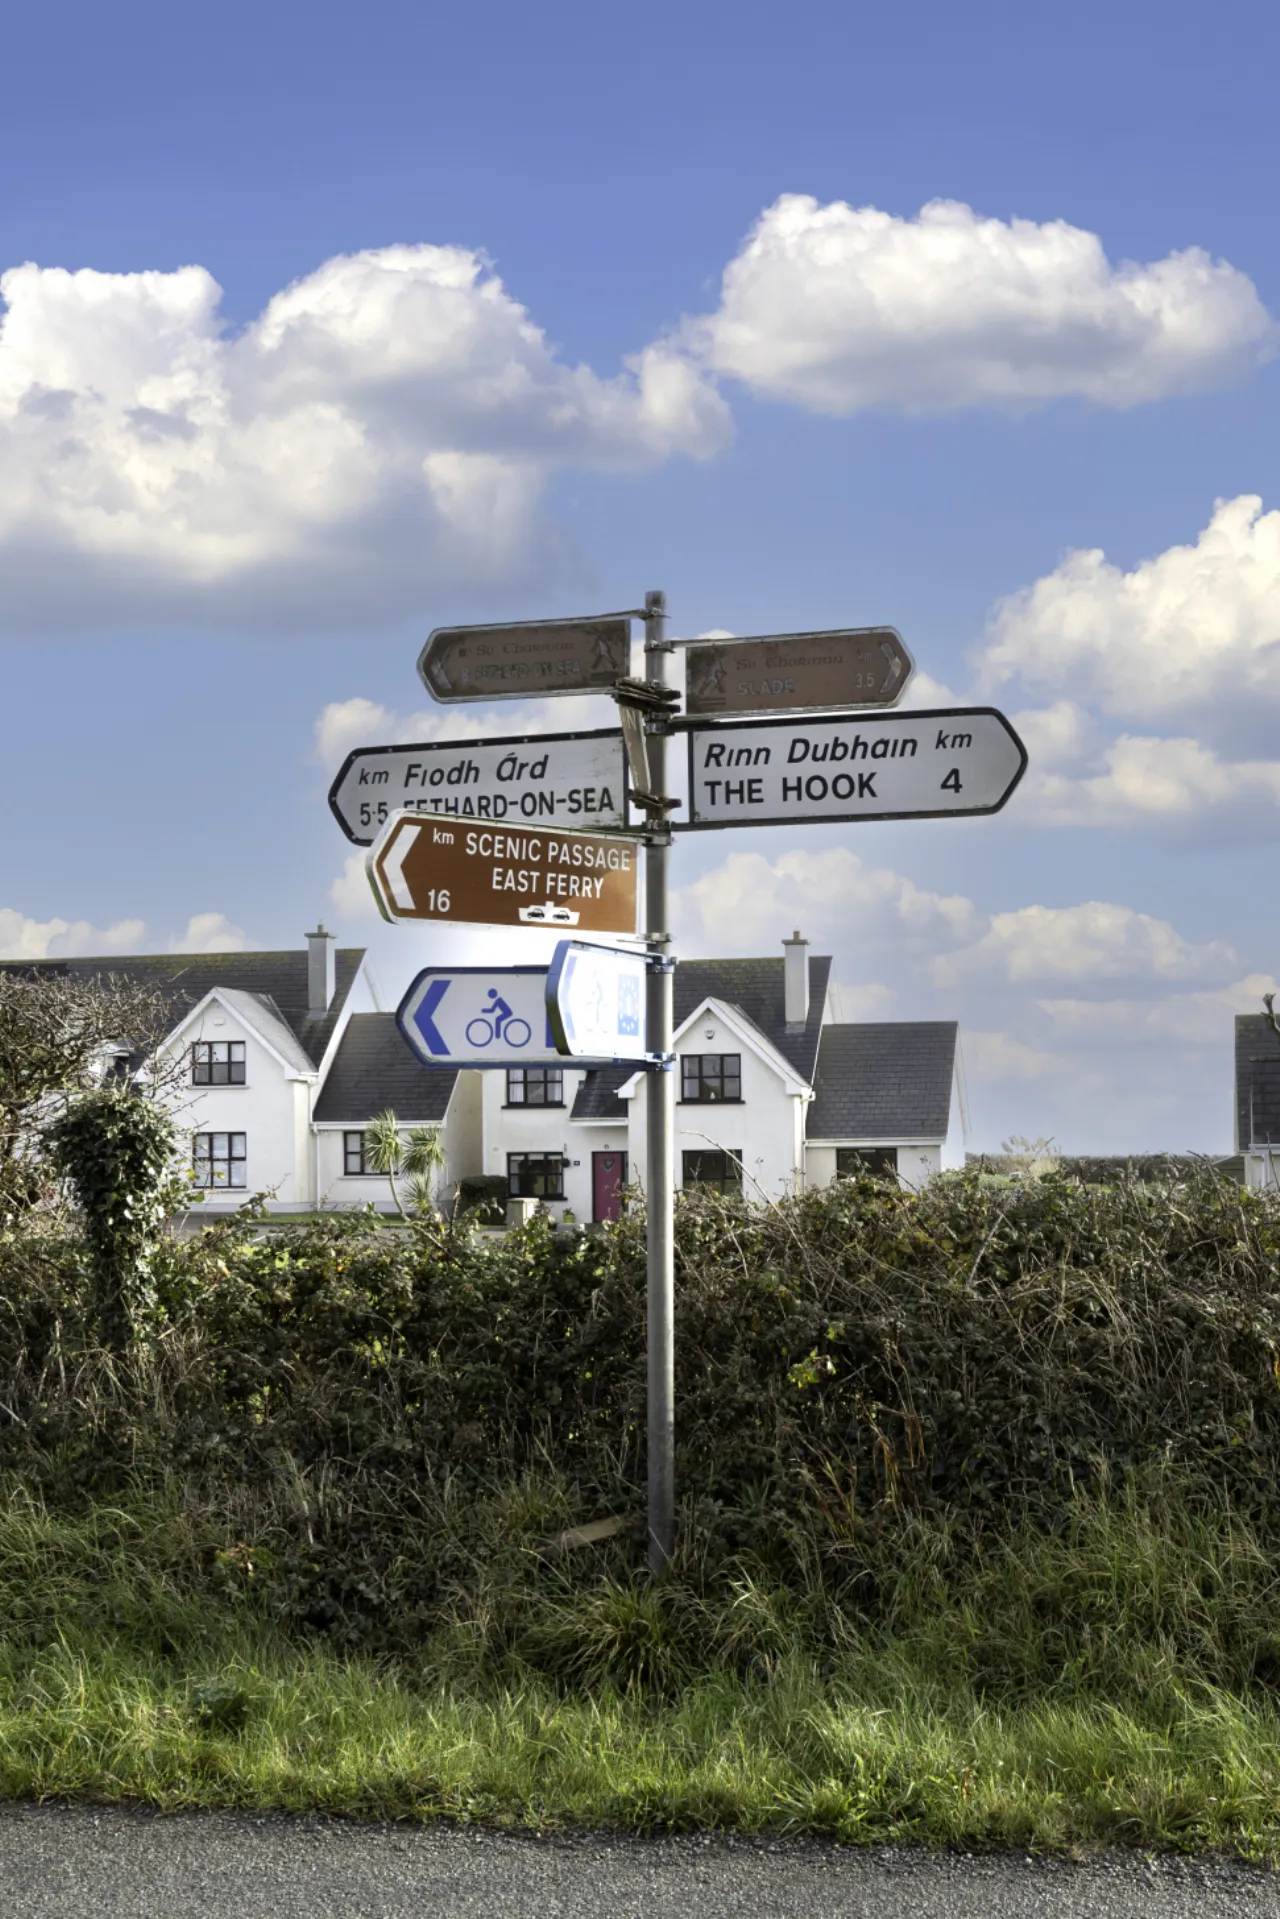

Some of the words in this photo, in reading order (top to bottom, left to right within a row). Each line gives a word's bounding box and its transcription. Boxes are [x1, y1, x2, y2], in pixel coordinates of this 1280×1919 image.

[737, 677, 796, 697] SLADE
[855, 672, 876, 689] 3.5
[704, 743, 772, 769] Rinn
[786, 735, 919, 764] Dubhain
[935, 730, 973, 750] km
[359, 767, 390, 785] km
[403, 759, 481, 788] Fiodh
[496, 752, 550, 782] Árd
[704, 778, 765, 806] THE
[782, 772, 879, 802] HOOK
[940, 768, 963, 794] 4
[432, 827, 454, 845] km
[465, 832, 542, 862] SCENIC
[548, 841, 631, 871] PASSAGE
[427, 889, 451, 913] 16
[491, 867, 540, 894] EAST
[546, 873, 604, 899] FERRY
